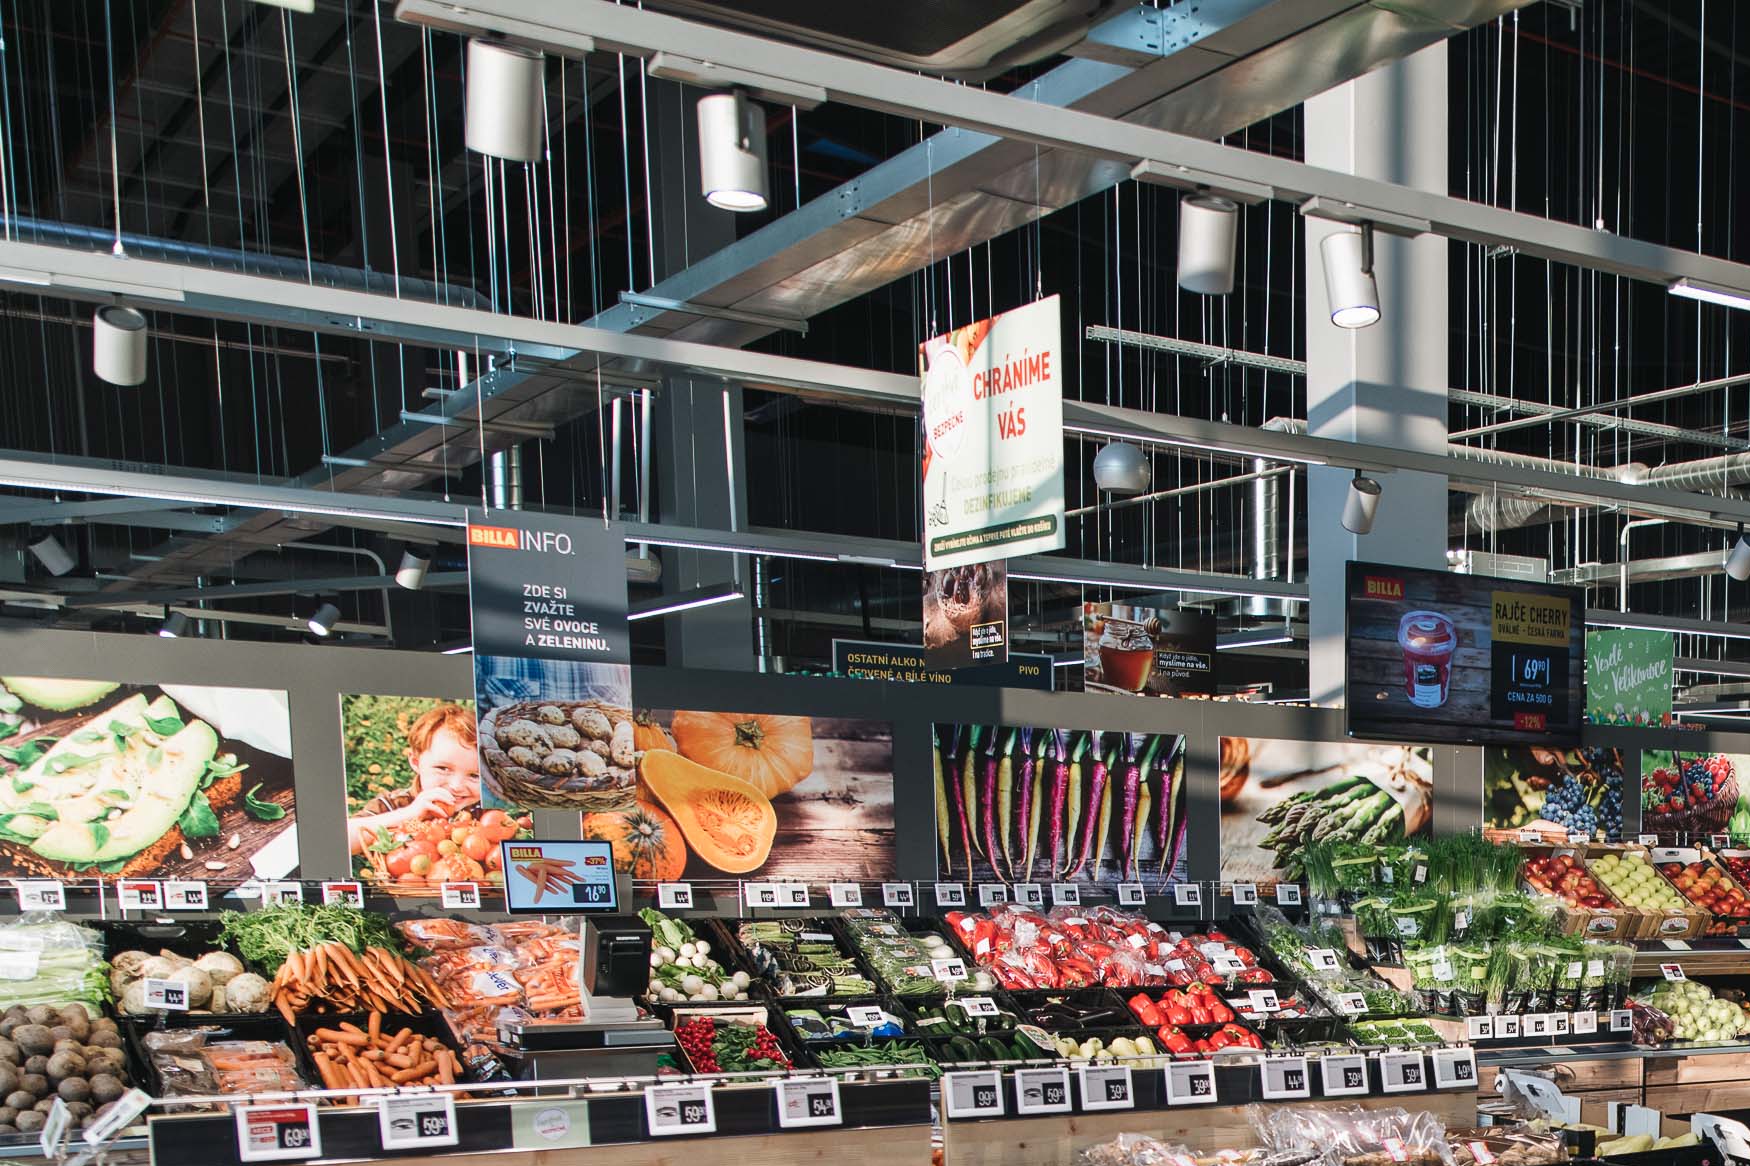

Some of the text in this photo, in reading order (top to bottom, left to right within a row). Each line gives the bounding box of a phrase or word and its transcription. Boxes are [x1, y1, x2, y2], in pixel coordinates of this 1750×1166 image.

[973, 348, 1051, 401] CHRÁNÍME
[997, 400, 1027, 440] VÁS
[471, 529, 517, 547] BILLA
[523, 584, 567, 599] ZDE SI
[1366, 580, 1402, 596] BILLA
[523, 600, 575, 616] ZVAŽTE
[1496, 601, 1568, 625] RAJČE CHERRY
[524, 616, 600, 634] SVÉ OVOCE
[525, 634, 536, 646] A
[847, 653, 888, 665] OSTATNÍ
[890, 656, 917, 667] ALKO
[905, 671, 927, 682] BÍLÉ
[929, 671, 952, 684] VÍNO
[1018, 665, 1040, 676] PIVO
[1611, 659, 1667, 695] Velikonoce
[1507, 692, 1525, 702] CENA
[1527, 693, 1535, 702] ZA
[1536, 694, 1546, 703] 500
[512, 848, 542, 858] BILLA
